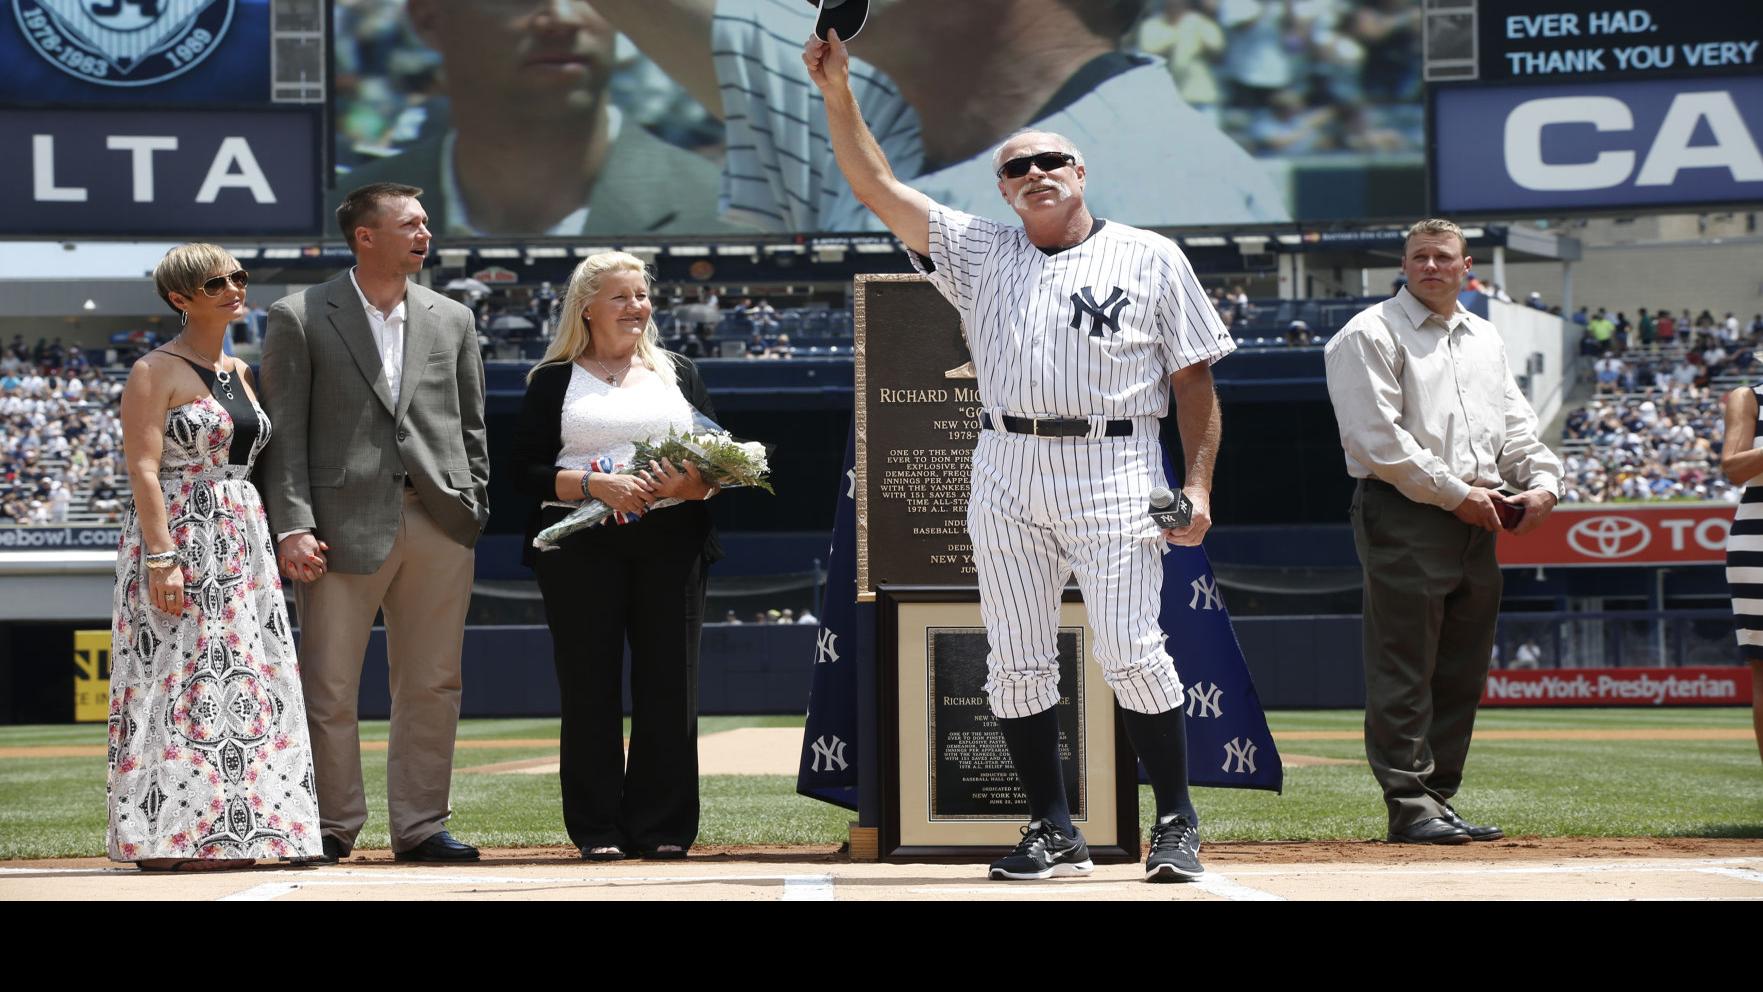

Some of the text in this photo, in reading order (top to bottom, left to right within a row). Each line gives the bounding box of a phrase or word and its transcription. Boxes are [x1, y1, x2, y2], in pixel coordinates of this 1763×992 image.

[1506, 10, 1658, 39] EVER HAD.
[165, 28, 213, 69] 1989
[1505, 41, 1758, 75] THANK YOU VERY
[880, 388, 948, 403] RICHARD
[933, 421, 958, 430] NEW
[885, 470, 938, 478] DEMEANOR,
[930, 555, 957, 564] NEW
[1487, 675, 1736, 704] NewYork-Presbyterian
[943, 696, 983, 706] RICHARD
